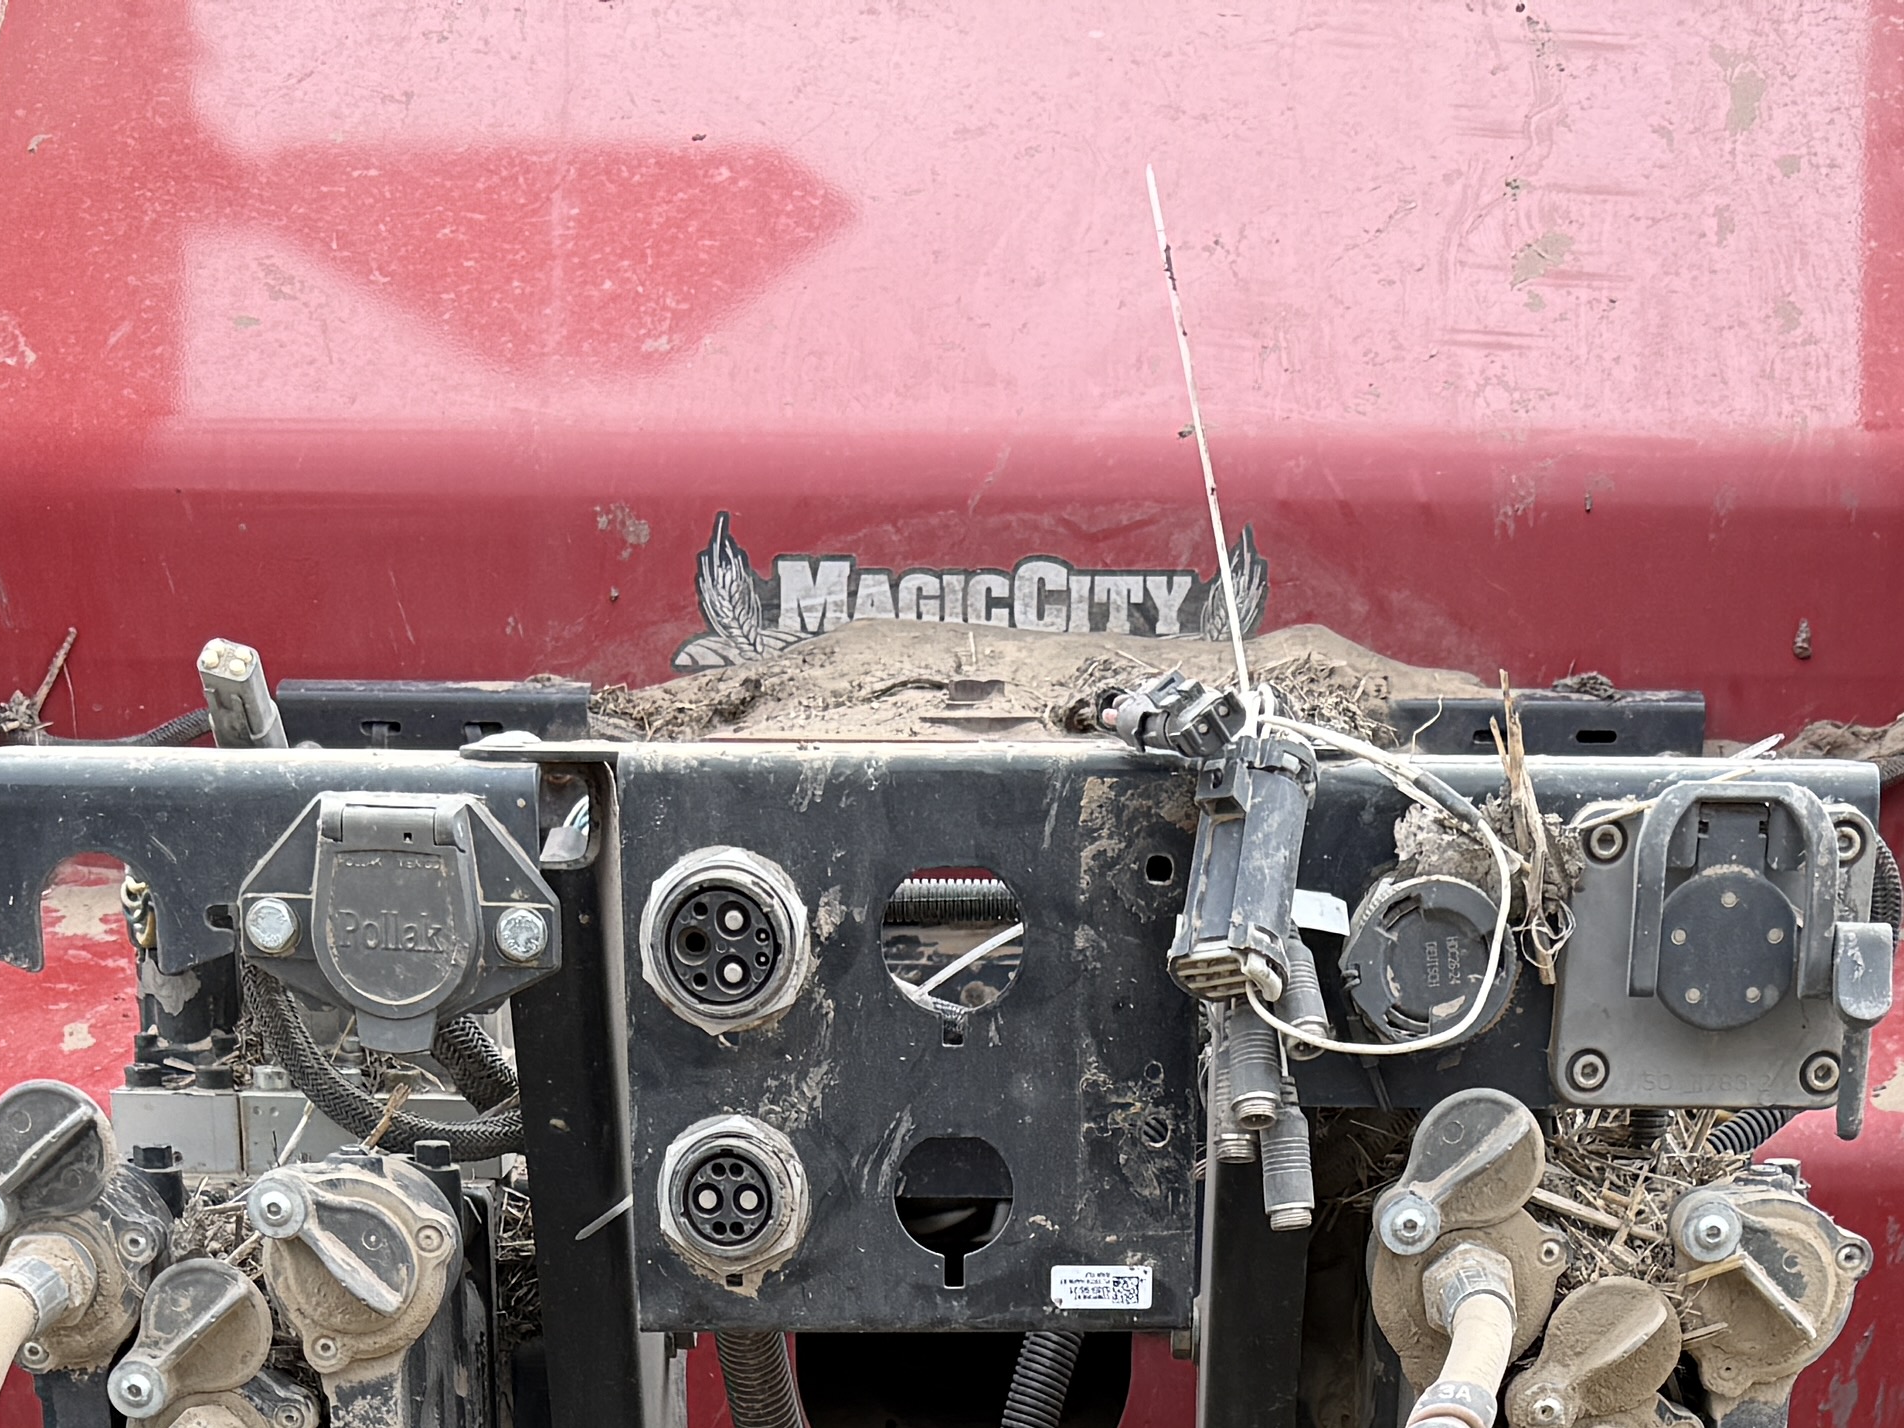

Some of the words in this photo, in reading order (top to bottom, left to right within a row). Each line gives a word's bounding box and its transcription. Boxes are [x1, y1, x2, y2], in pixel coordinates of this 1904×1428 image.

[336, 909, 444, 953] Pollak
[1425, 941, 1441, 988] DEUTSCH
[1439, 1384, 1472, 1402] 3A
